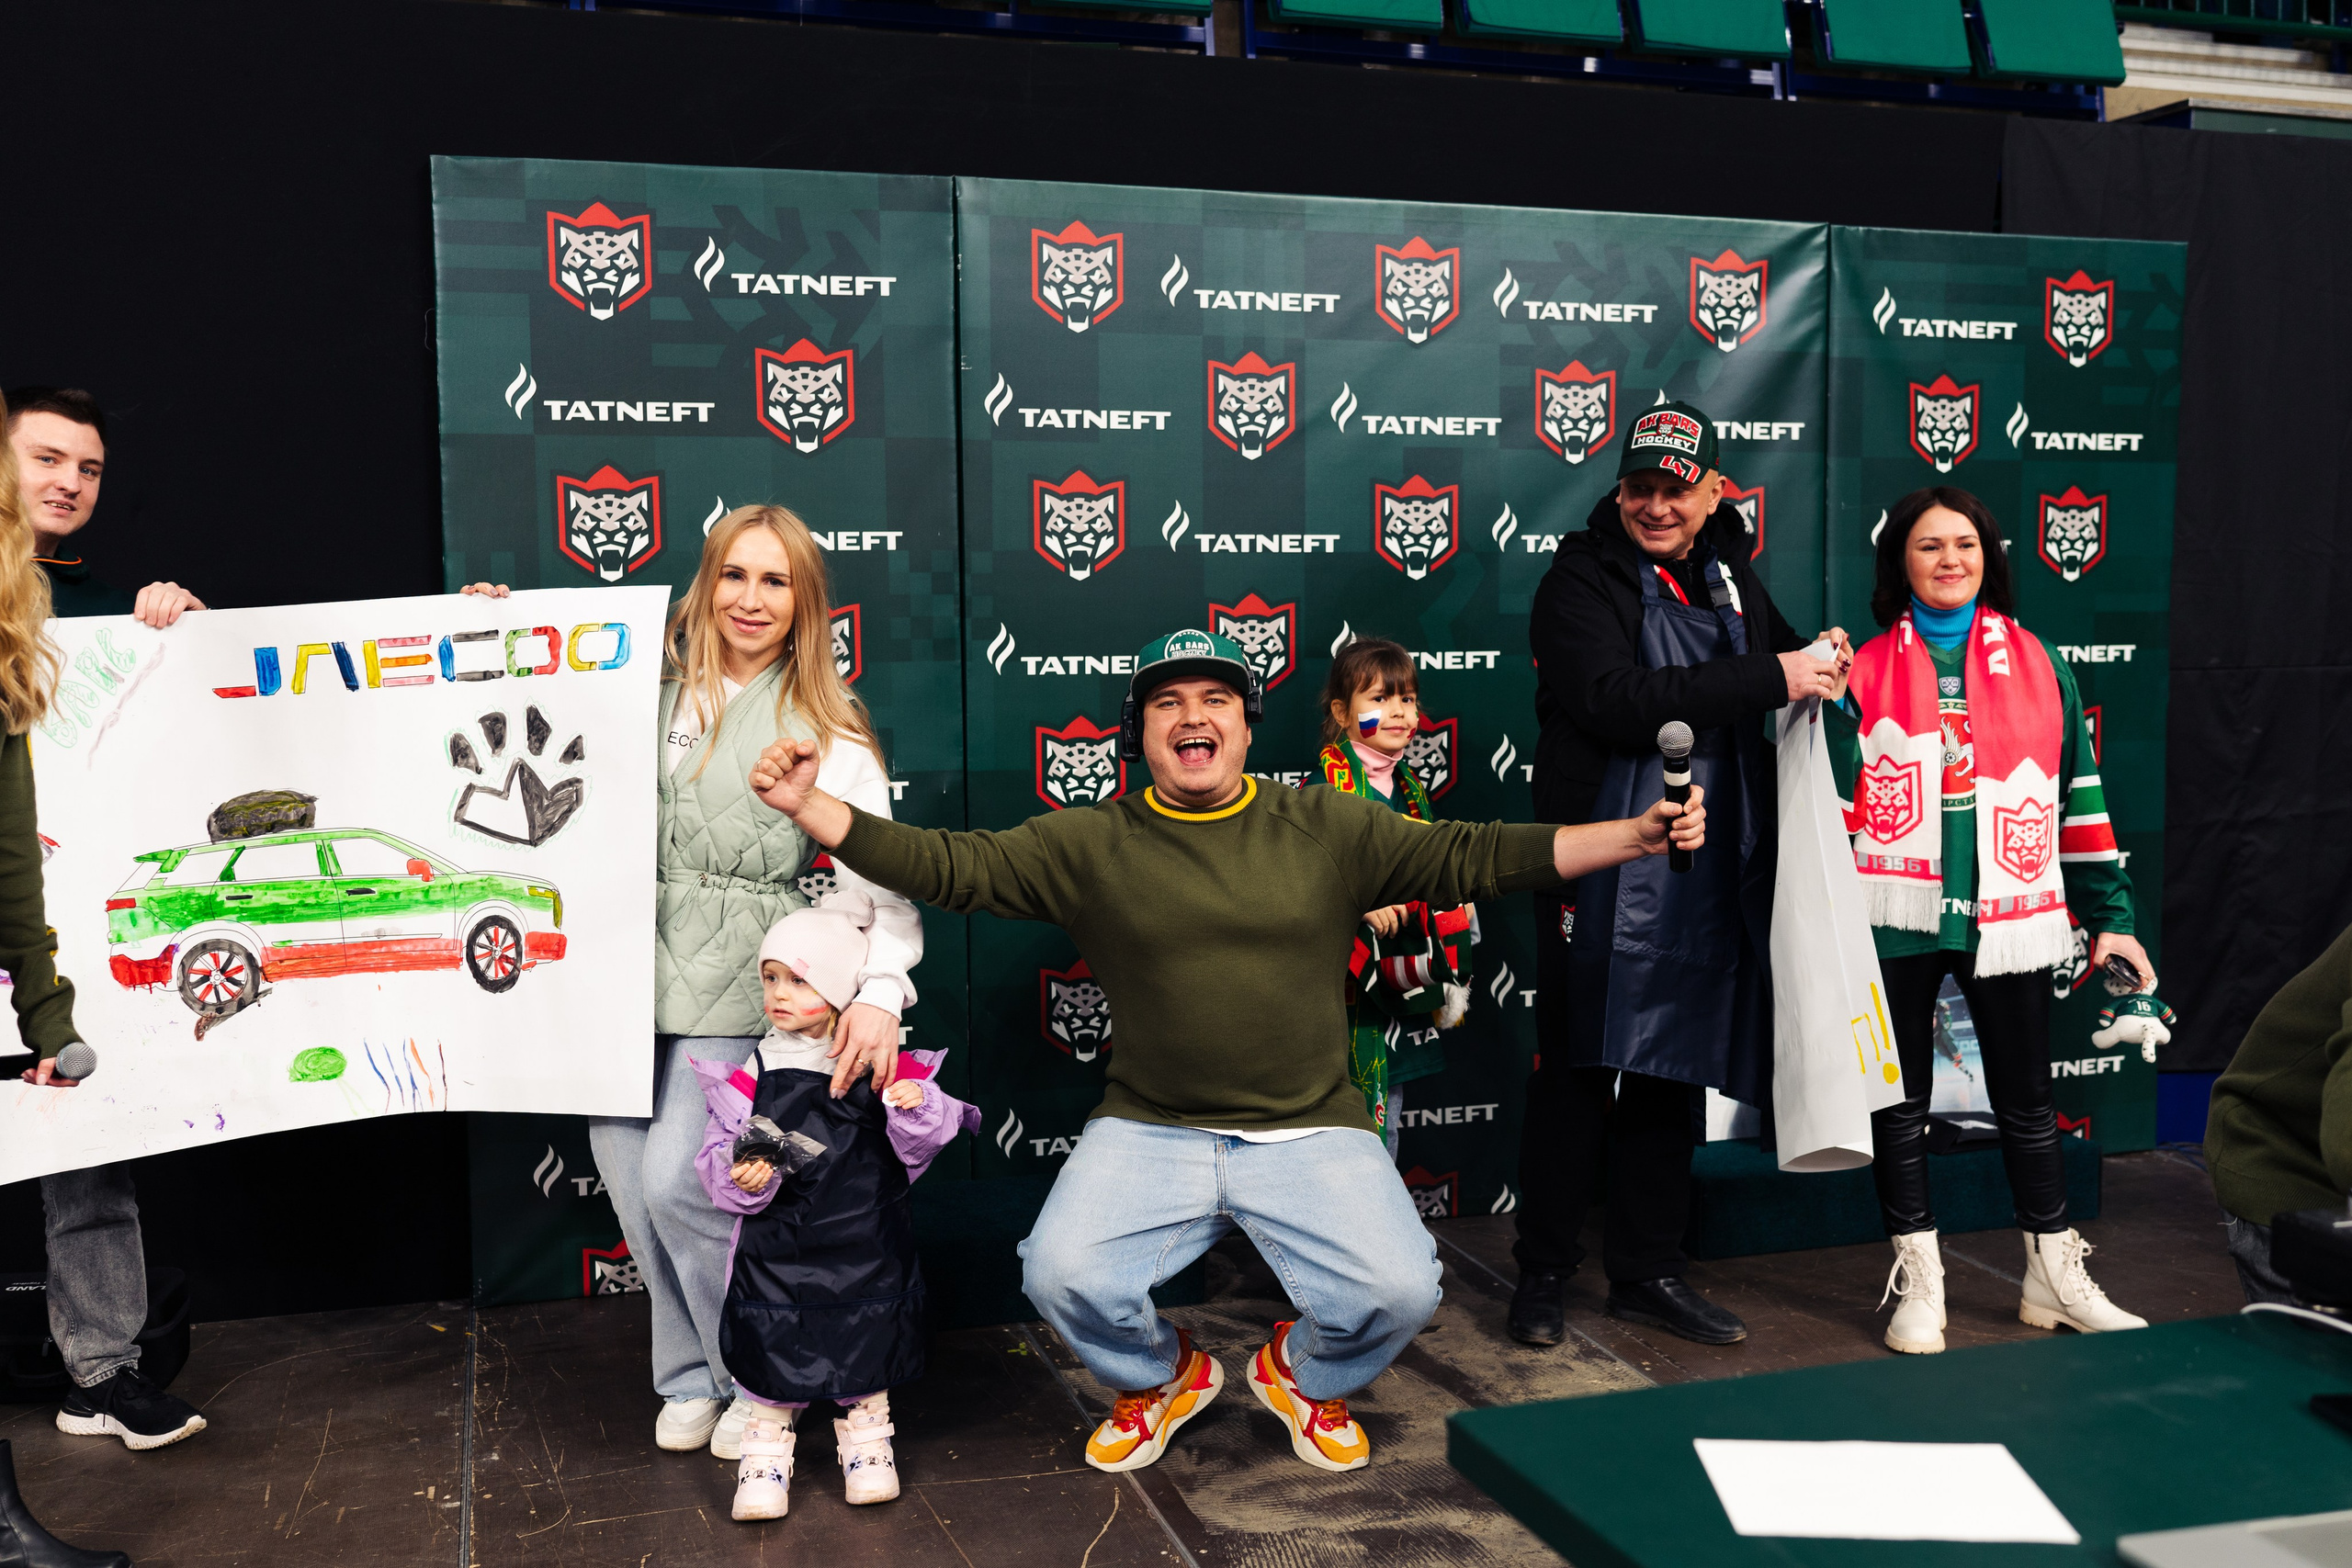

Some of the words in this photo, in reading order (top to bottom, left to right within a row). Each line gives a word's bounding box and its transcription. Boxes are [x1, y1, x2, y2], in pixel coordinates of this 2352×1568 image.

[730, 273, 898, 297] TATNEFT
[1193, 289, 1341, 313] TATNEFT
[1522, 300, 1658, 323] TATNEFT
[1898, 318, 2018, 340] TATNEFT
[543, 400, 716, 423] TATNEFT
[1018, 408, 1171, 431] TATNEFT
[1362, 415, 1502, 436] TATNEFT
[1637, 414, 1659, 433] AK
[1659, 413, 1700, 438] BARS
[1711, 421, 1805, 441] TNEFT
[1637, 435, 1691, 449] HOCKEY
[2030, 432, 2143, 452] TATNEFT
[1659, 455, 1701, 483] 47
[809, 531, 903, 551] NEFT
[1193, 534, 1340, 553] TATNEFT
[1170, 643, 1181, 651] AK
[1185, 641, 1209, 650] BARS
[2056, 644, 2137, 663] TNEFT
[1020, 655, 1139, 676] TATNE
[1406, 650, 1501, 671] NEFT
[1871, 855, 1921, 873] 1956
[2017, 892, 2051, 911] 1956
[2136, 1000, 2152, 1011] 16
[2050, 1055, 2125, 1078] TNEFT
[1397, 1103, 1499, 1129] TNEFT
